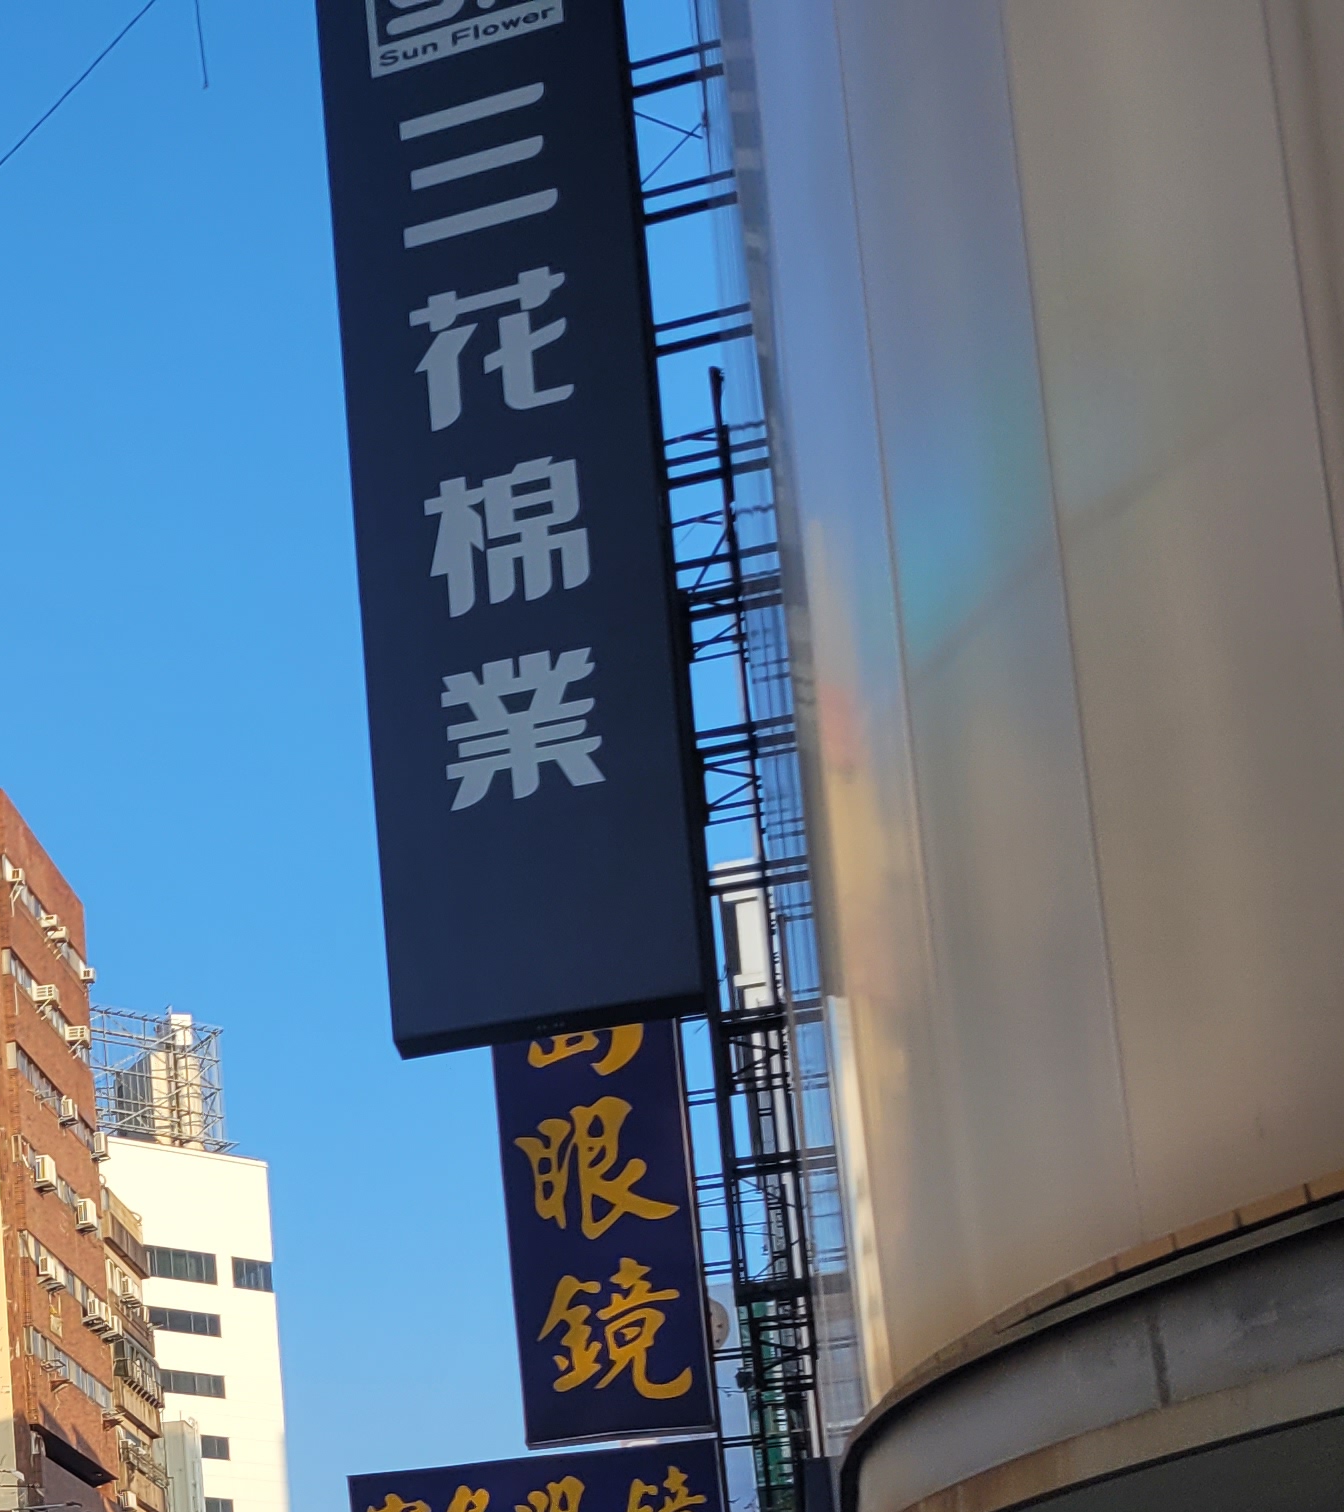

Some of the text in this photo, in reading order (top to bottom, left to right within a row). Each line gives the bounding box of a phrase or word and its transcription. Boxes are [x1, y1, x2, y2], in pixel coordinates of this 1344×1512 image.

[380, 6, 555, 67] Sun Flower
[398, 80, 607, 812] 三花棉業
